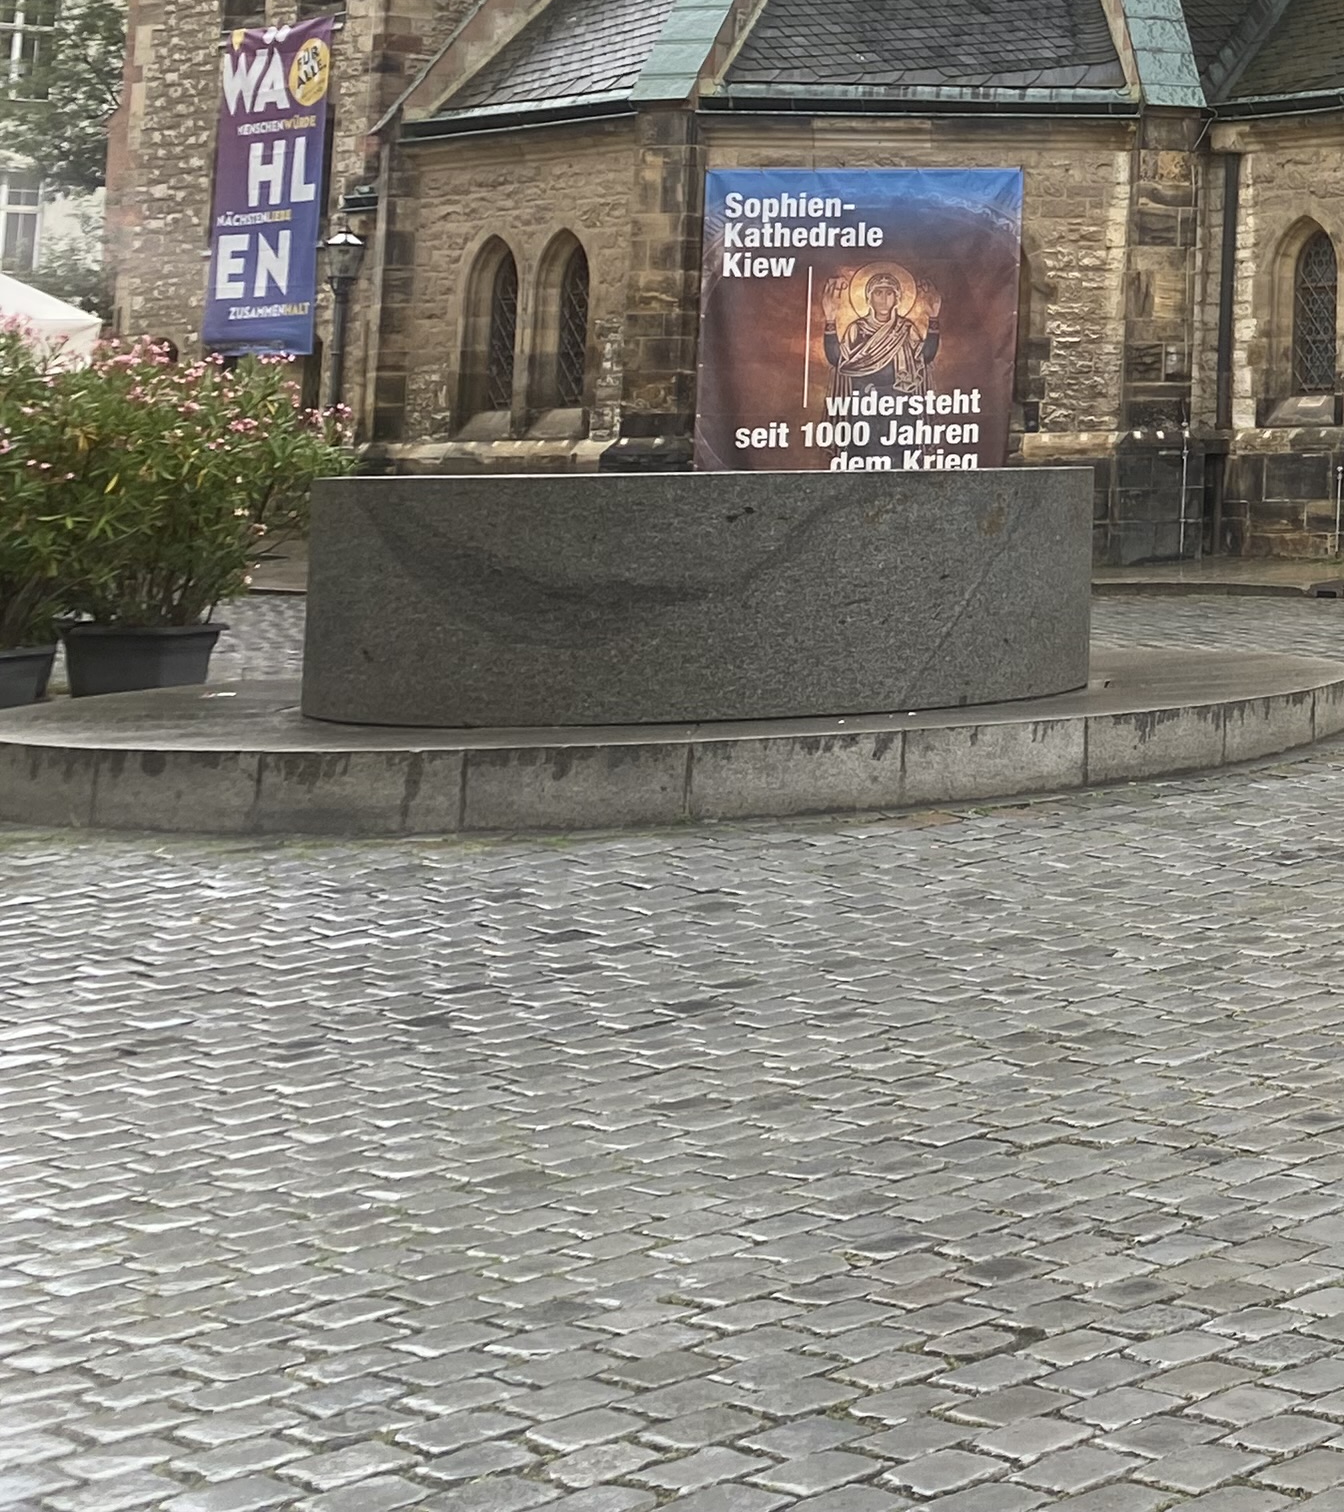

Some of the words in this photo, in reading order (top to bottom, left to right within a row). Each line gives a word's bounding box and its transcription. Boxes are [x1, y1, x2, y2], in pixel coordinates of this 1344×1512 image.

[248, 135, 316, 208] HL
[724, 191, 856, 223] Sophien-
[723, 221, 884, 249] Kathedrale
[215, 229, 292, 300] EN
[721, 252, 796, 278] Kiew
[825, 388, 982, 417] widersteht
[734, 421, 790, 450] seit
[800, 421, 871, 448] 1000
[879, 419, 980, 447] Jahren
